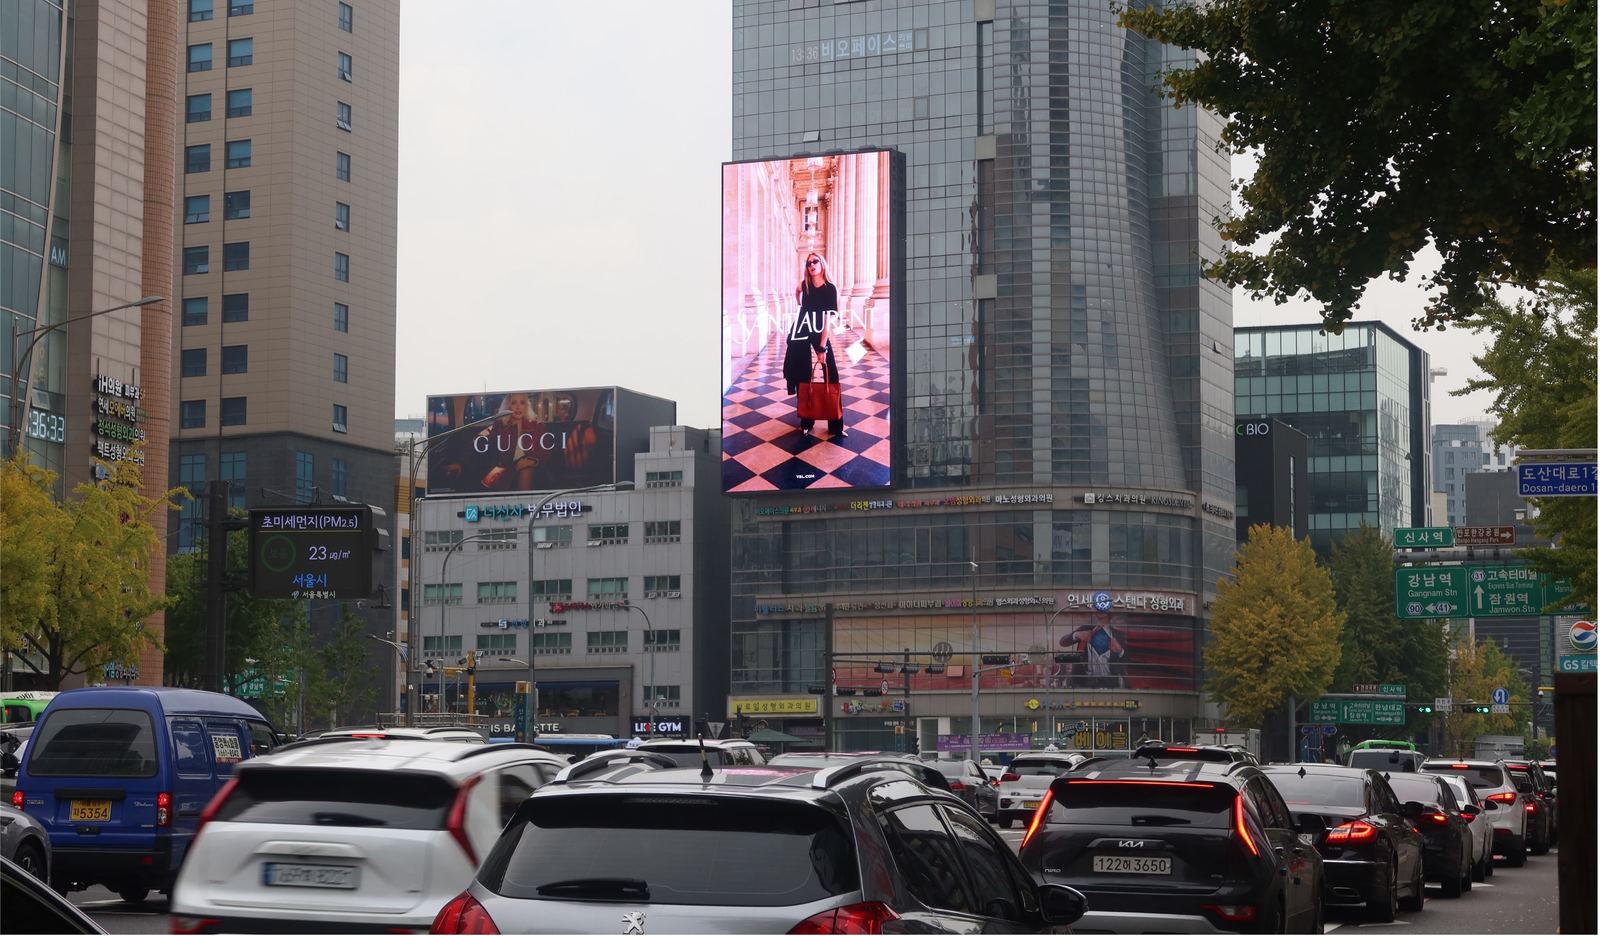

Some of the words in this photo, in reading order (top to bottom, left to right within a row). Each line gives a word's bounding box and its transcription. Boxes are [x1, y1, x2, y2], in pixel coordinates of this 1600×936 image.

[821, 34, 897, 60] 비오페이스
[51, 246, 66, 266] AM
[790, 304, 878, 341] LAURENT
[25, 410, 65, 442] :36:33
[1246, 422, 1269, 436] BIO
[473, 431, 568, 453] GUCCI
[1522, 483, 1588, 493] Dosan-daero
[1096, 492, 1146, 505] 킹스치과의원
[261, 514, 358, 530] 초미세먼지(PM2.5)
[1404, 531, 1444, 543] 신사역
[309, 546, 327, 560] 23
[292, 573, 327, 588] 서울시
[1408, 572, 1452, 587] 강남역
[1487, 568, 1537, 580] 고속터미널
[301, 590, 336, 599] 서울특별시
[1408, 589, 1443, 598] Gangnam
[1444, 588, 1457, 596] Stn
[1489, 592, 1529, 605] 잠원역
[1067, 593, 1092, 608] 연세
[1489, 605, 1521, 614] Jamwon
[1522, 603, 1536, 613] Stn
[1563, 660, 1579, 670] GS
[503, 723, 560, 733] BAETTE
[658, 721, 681, 732] GYM
